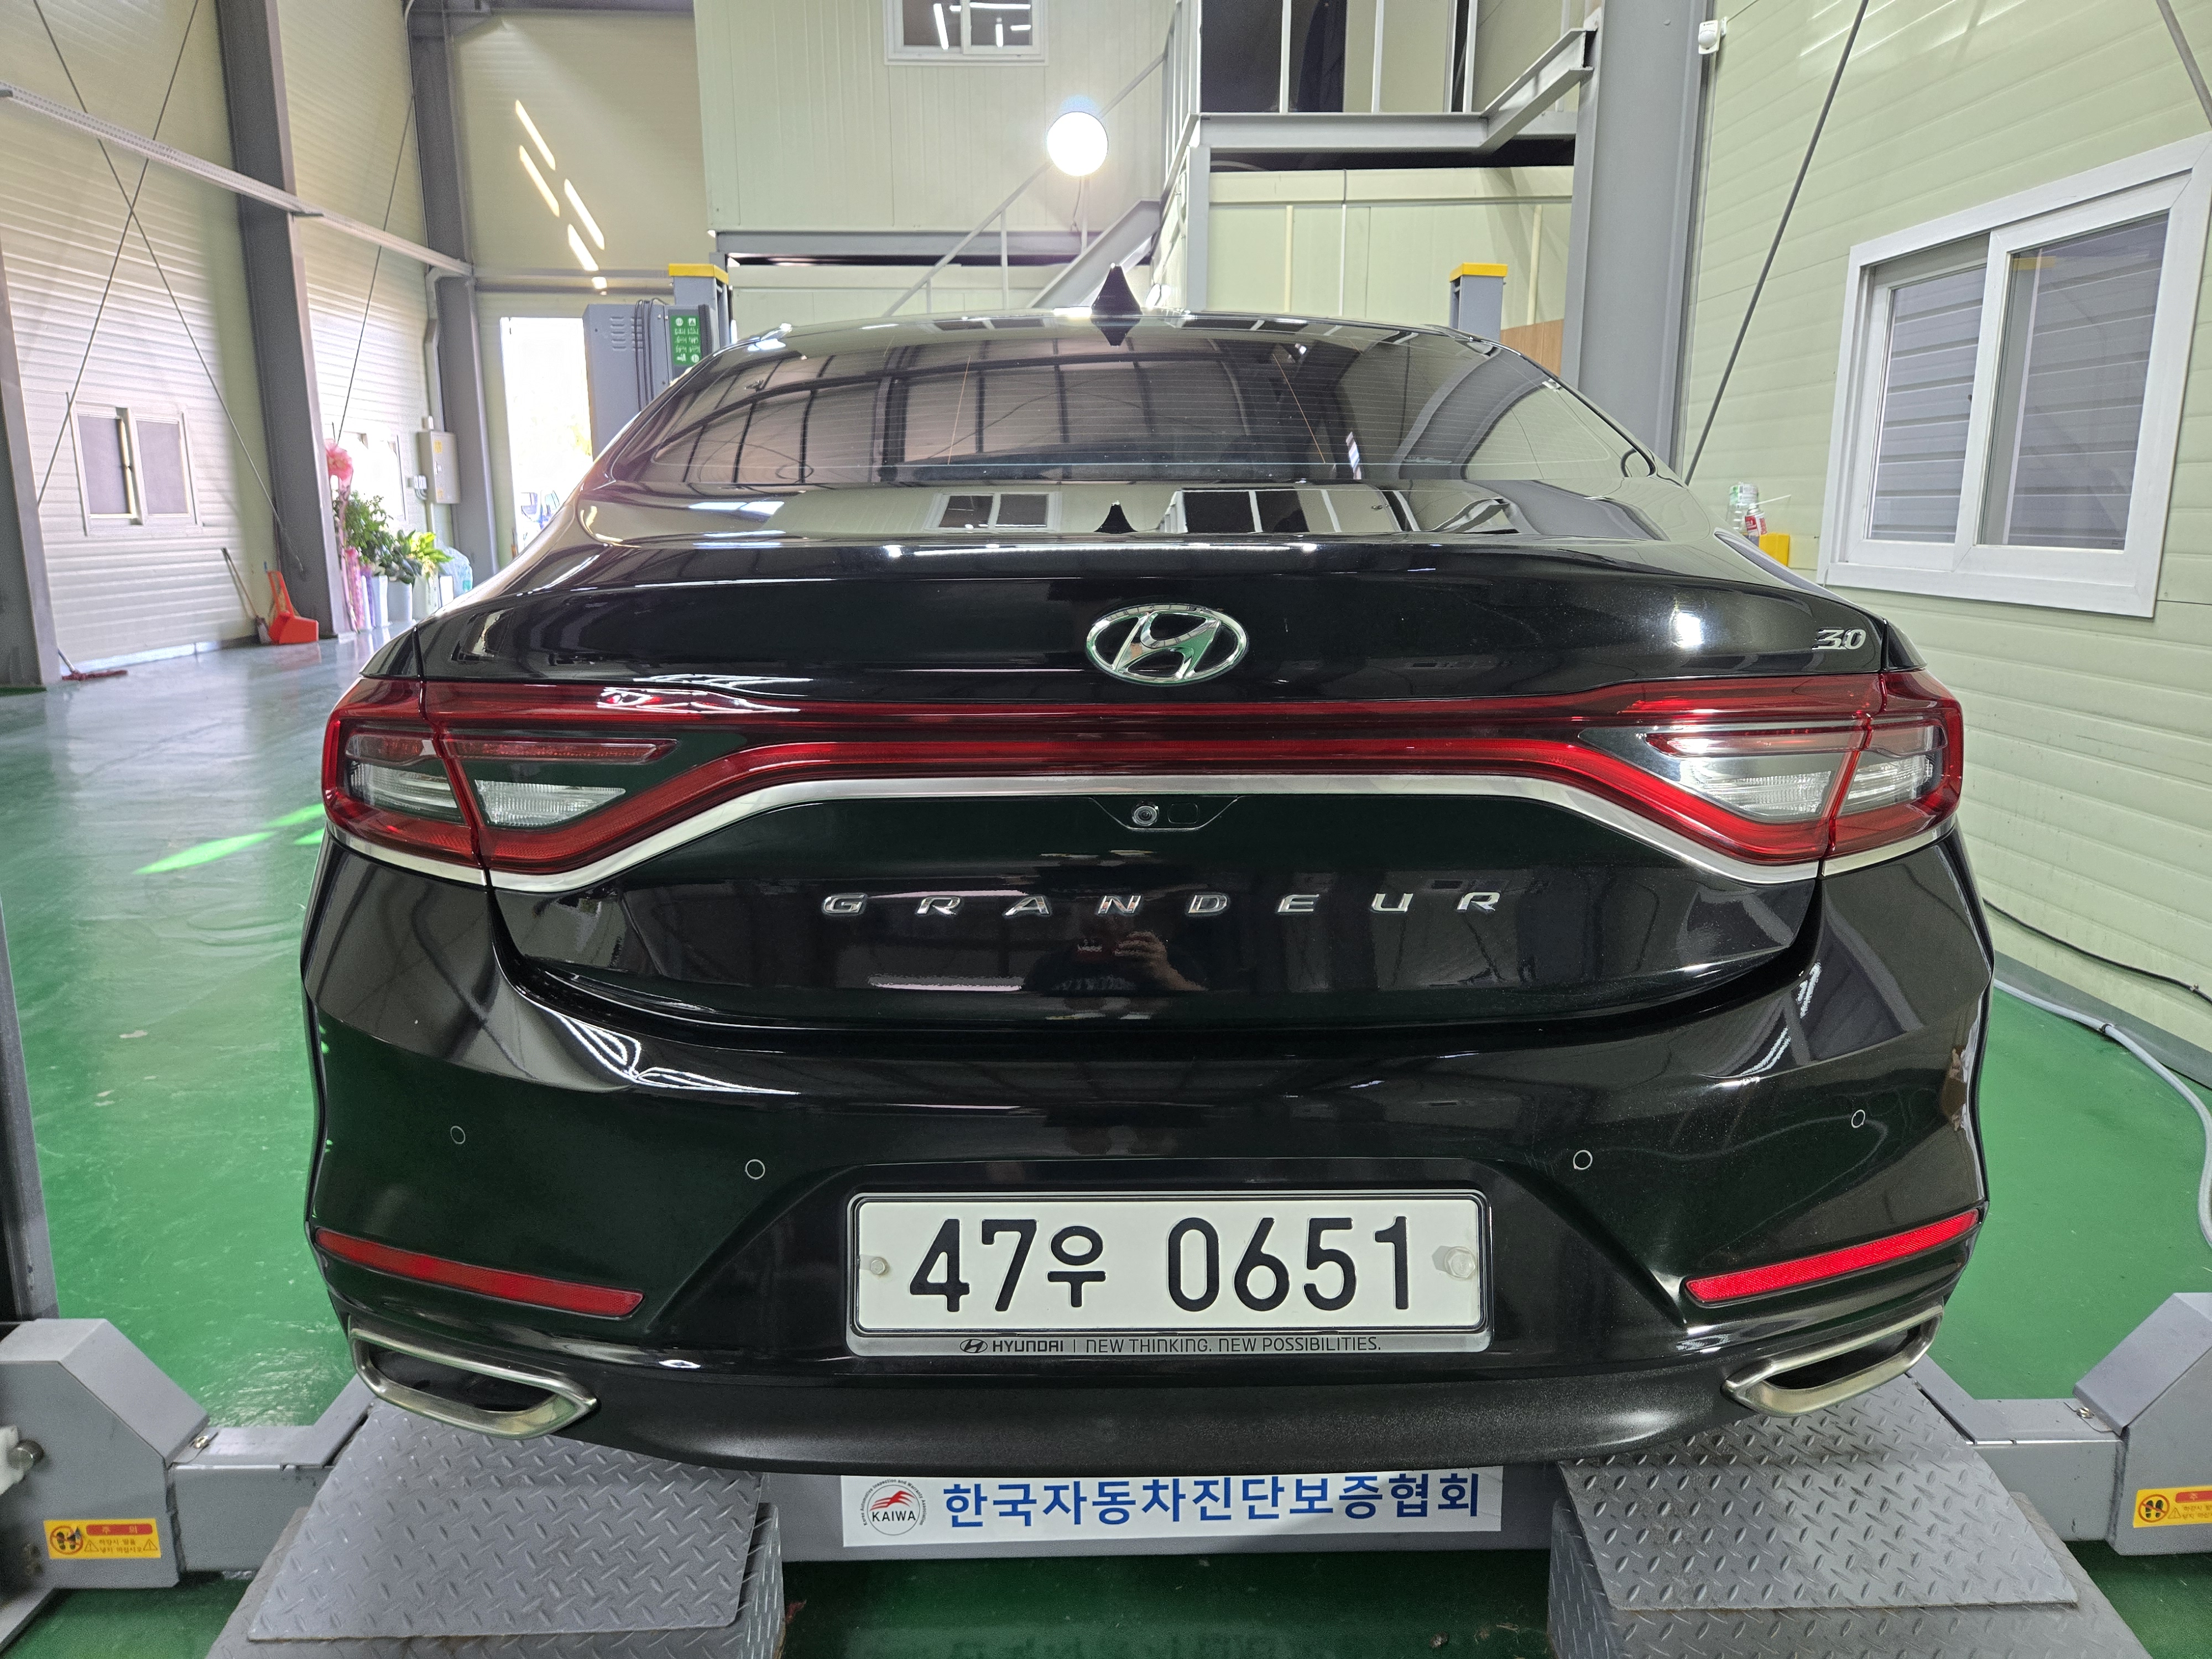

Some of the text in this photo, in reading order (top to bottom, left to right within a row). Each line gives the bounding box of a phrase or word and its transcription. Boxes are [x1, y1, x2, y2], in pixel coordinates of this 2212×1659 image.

[823, 891, 1500, 914] GRANDEUR
[910, 1215, 1409, 1312] 47우 0651
[993, 1336, 1381, 1353] HYUNDAI NEW THINKING. NEW POSSIBILITIES.
[860, 1488, 873, 1511] Automotive
[873, 1478, 897, 1489] Inspection
[907, 1482, 923, 1499] Warranty
[919, 1499, 927, 1526] Association
[872, 1510, 916, 1522] KAIWA
[943, 1473, 1479, 1527] 한국자동차진단보증협회
